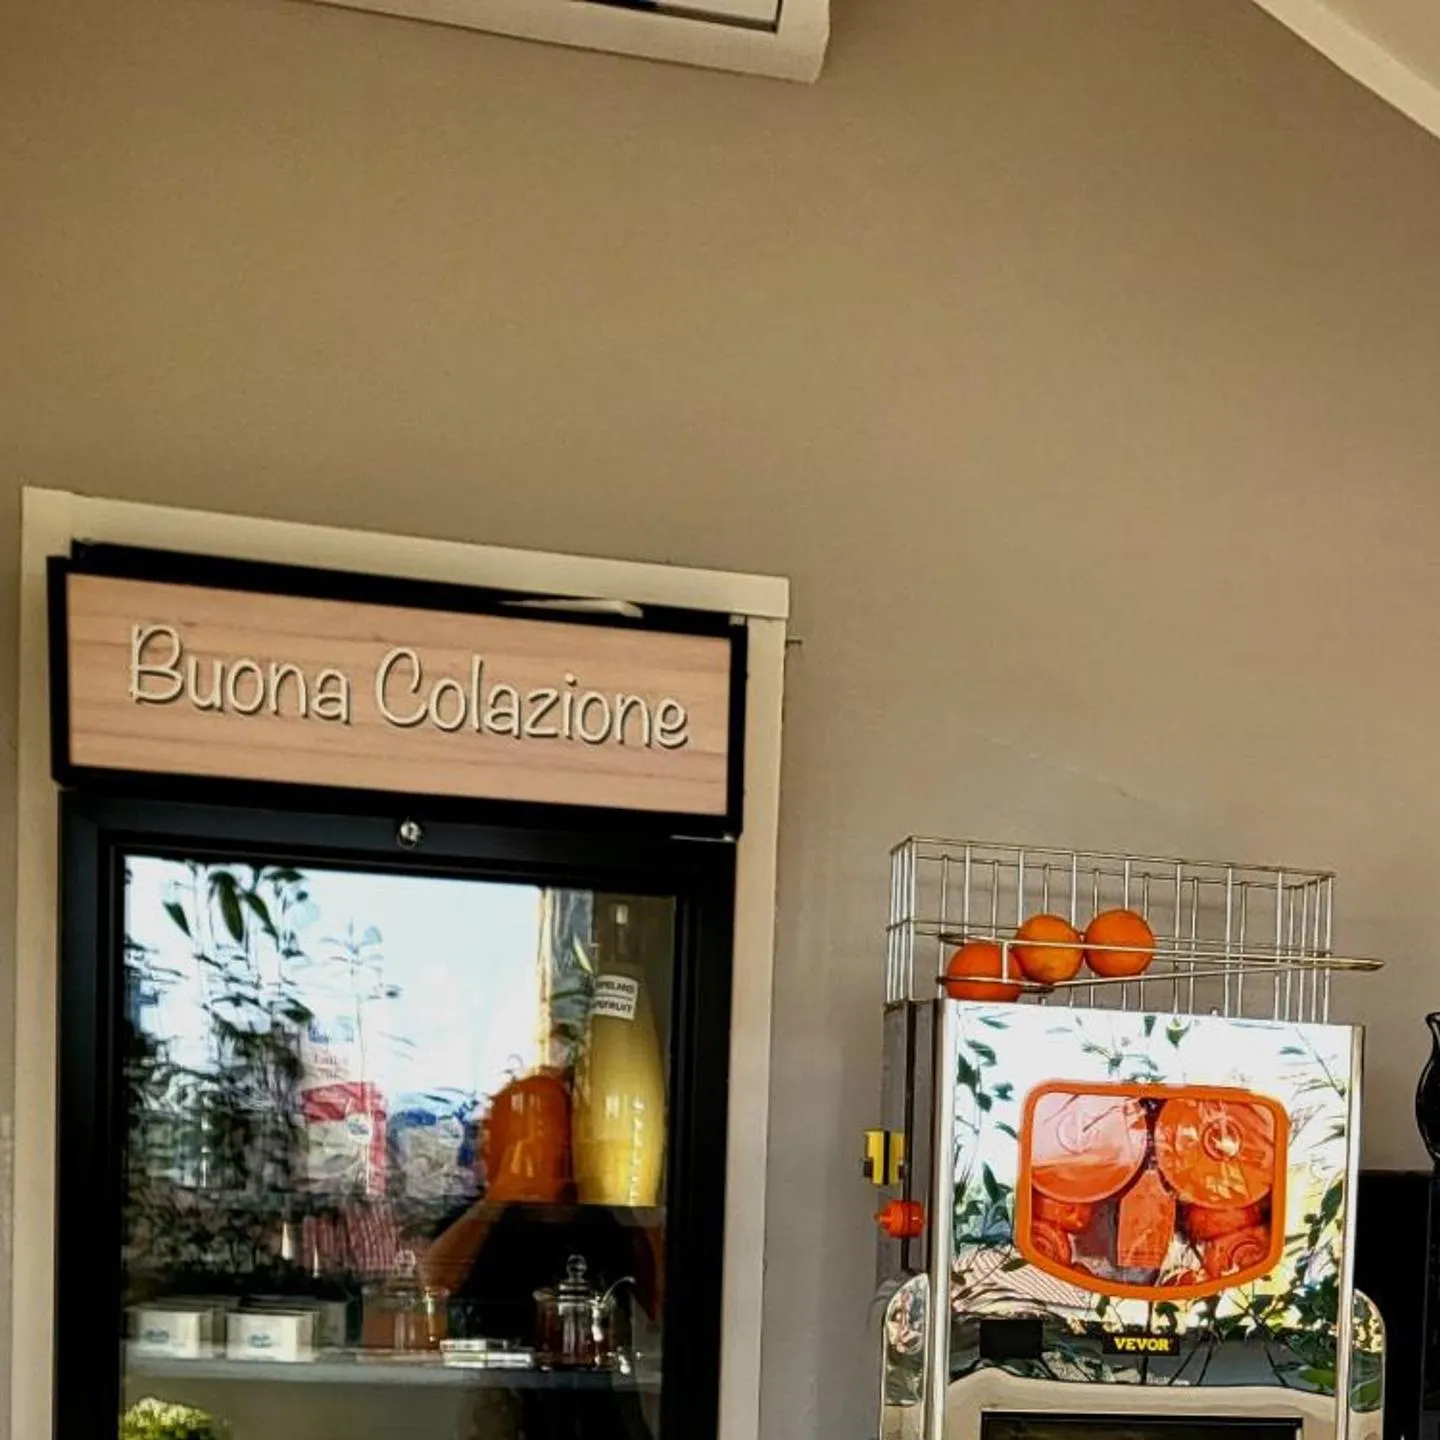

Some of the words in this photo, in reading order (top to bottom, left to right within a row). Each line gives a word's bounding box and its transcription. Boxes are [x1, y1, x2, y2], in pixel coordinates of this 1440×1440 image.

[128, 624, 351, 725] Buona
[375, 647, 690, 749] Colazione
[1113, 1336, 1170, 1352] VEVOR
